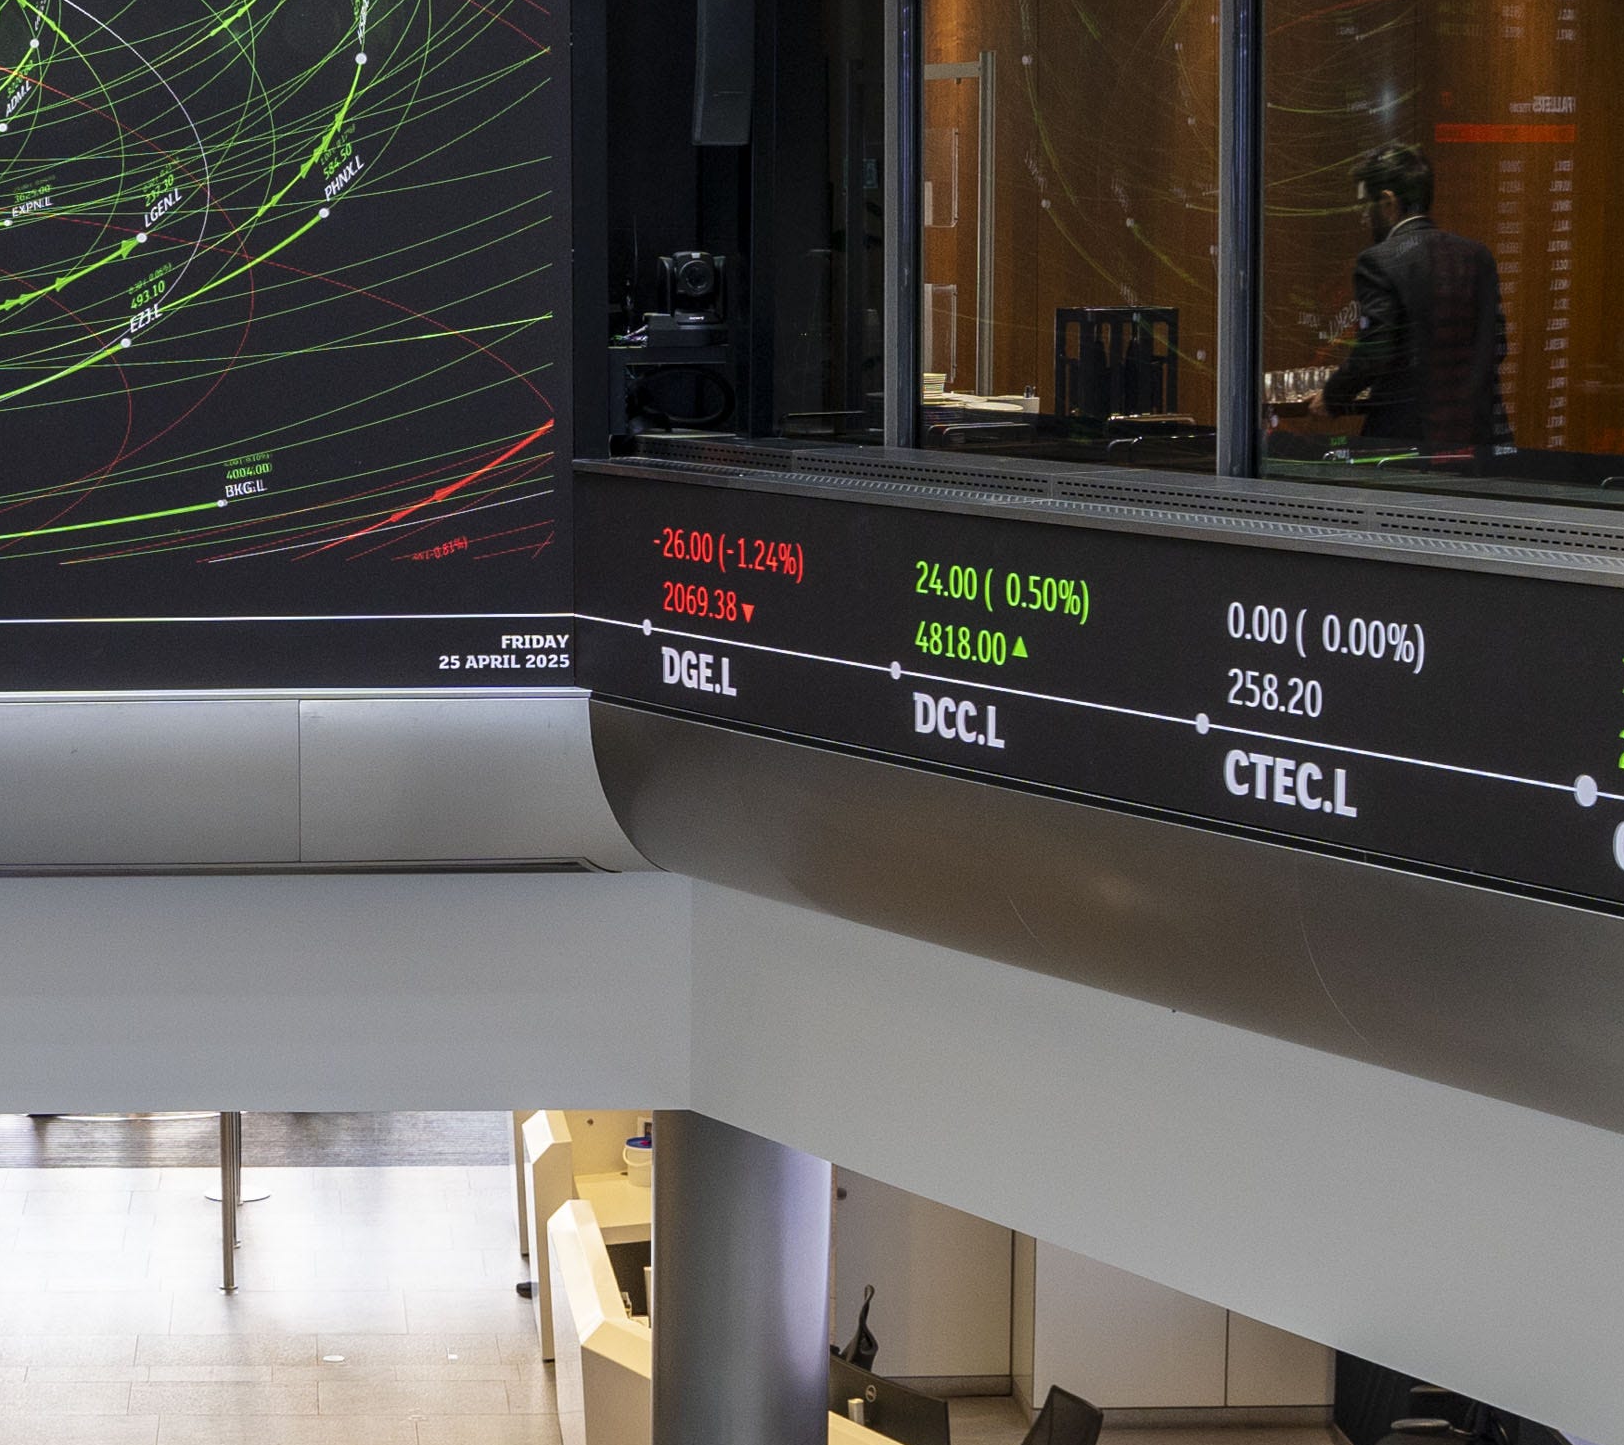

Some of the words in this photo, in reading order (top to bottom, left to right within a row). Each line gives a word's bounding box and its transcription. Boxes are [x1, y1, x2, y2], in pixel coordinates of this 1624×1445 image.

[654, 528, 713, 563] -26.00
[719, 534, 803, 583] (-1.24%)
[663, 581, 737, 621] 2069.38
[439, 655, 460, 669] 25
[465, 655, 521, 669] APRIL
[526, 654, 570, 668] 2025
[502, 634, 569, 649] FRIDAY
[915, 621, 1006, 665] 4818.00
[662, 646, 737, 696] DGE.L
[1228, 668, 1322, 717] 258.20
[913, 692, 1005, 748] DCC.L
[1224, 750, 1357, 817] CTEC.L
